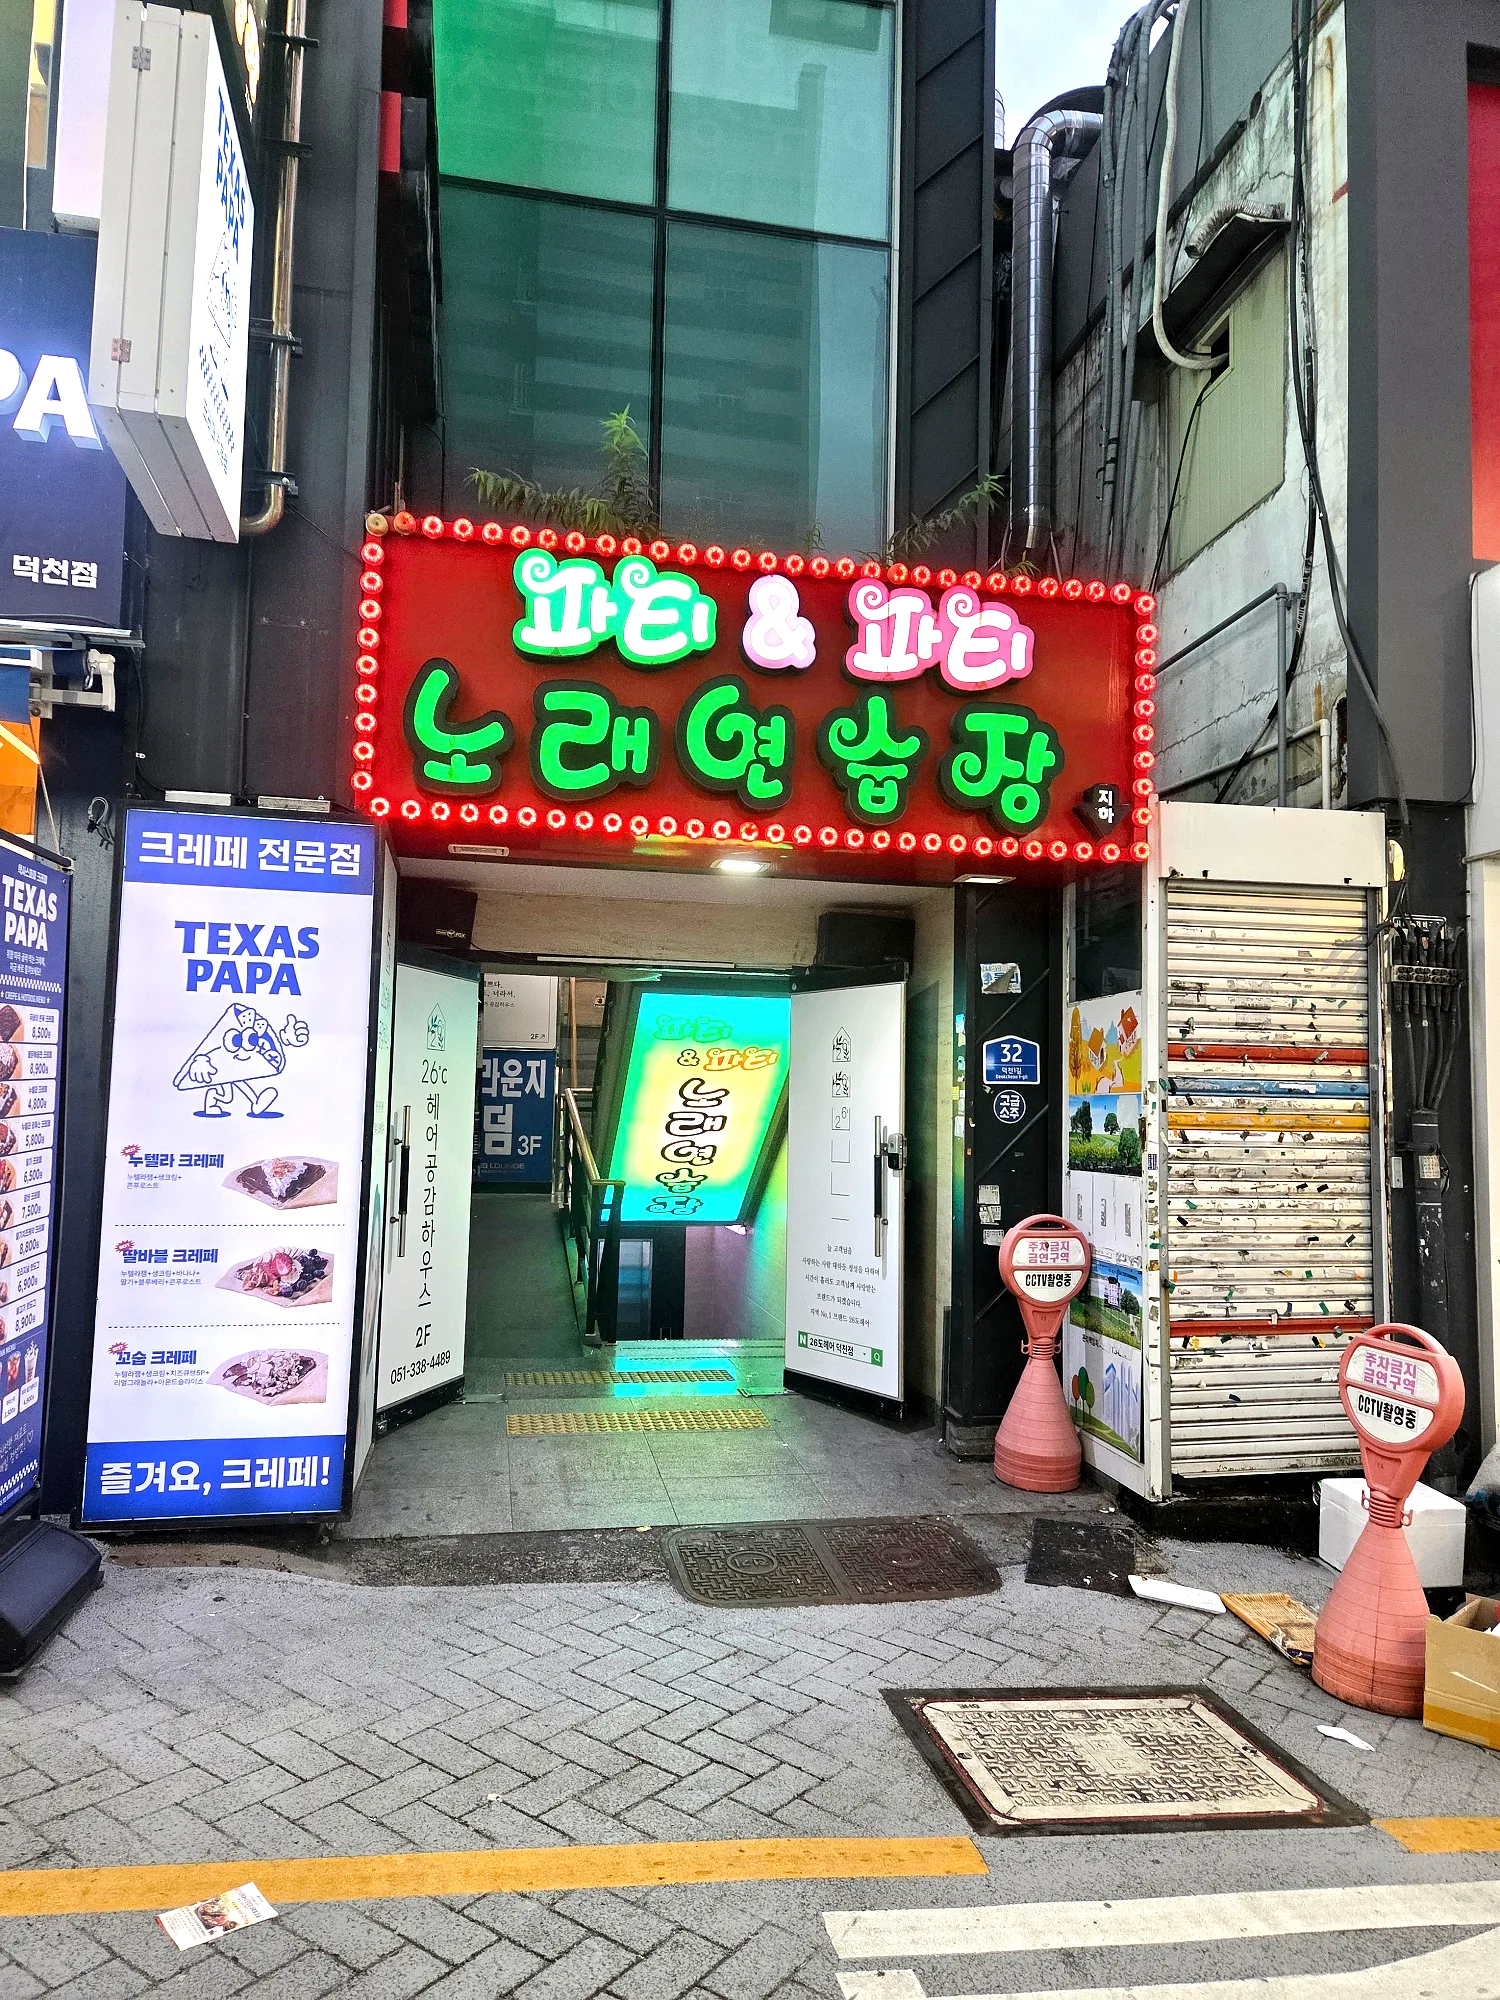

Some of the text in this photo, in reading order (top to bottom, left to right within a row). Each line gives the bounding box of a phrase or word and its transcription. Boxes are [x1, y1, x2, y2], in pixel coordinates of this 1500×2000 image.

[218, 85, 247, 227] TEXAS
[215, 145, 240, 264] PAPA
[12, 554, 98, 588] 덕천점
[513, 548, 1034, 691] 파티 & 파티
[411, 665, 1057, 825] 노래연습장
[1096, 788, 1115, 825] 지하
[139, 832, 361, 876] 크레페 전문점
[2, 874, 58, 922] TEXAS
[4, 911, 48, 952] PAPA
[174, 920, 319, 960] TEXAS
[186, 959, 302, 996] PAPA
[653, 1015, 733, 1043] 파티
[677, 1047, 780, 1071] & 파티
[1000, 1043, 1023, 1063] 32
[1001, 1067, 1022, 1075] 덕천1길
[999, 1107, 1020, 1119] 소주
[1000, 1094, 1020, 1107] 고급
[517, 1135, 543, 1156] 3F
[646, 1077, 730, 1216] 노래연습장
[128, 1153, 224, 1168] 누텔라 크레페
[122, 1249, 219, 1263] 딸바블 크레페
[1028, 1241, 1070, 1252] 주차금지
[1028, 1252, 1070, 1264] 금연구역
[1025, 1273, 1072, 1287] CCTV촬영중
[415, 1324, 432, 1348] 2F
[809, 1337, 835, 1352] 26도헤어
[836, 1343, 854, 1357] 덕천점
[116, 1350, 197, 1365] 꼬숩 크레페
[390, 1350, 451, 1385] 051-338-4489
[1365, 1352, 1417, 1378] 주차금지
[1363, 1368, 1416, 1395] 금연구역
[1358, 1394, 1417, 1430] CCTV촬영중
[99, 1456, 331, 1496] 즐겨요, 크레페!
